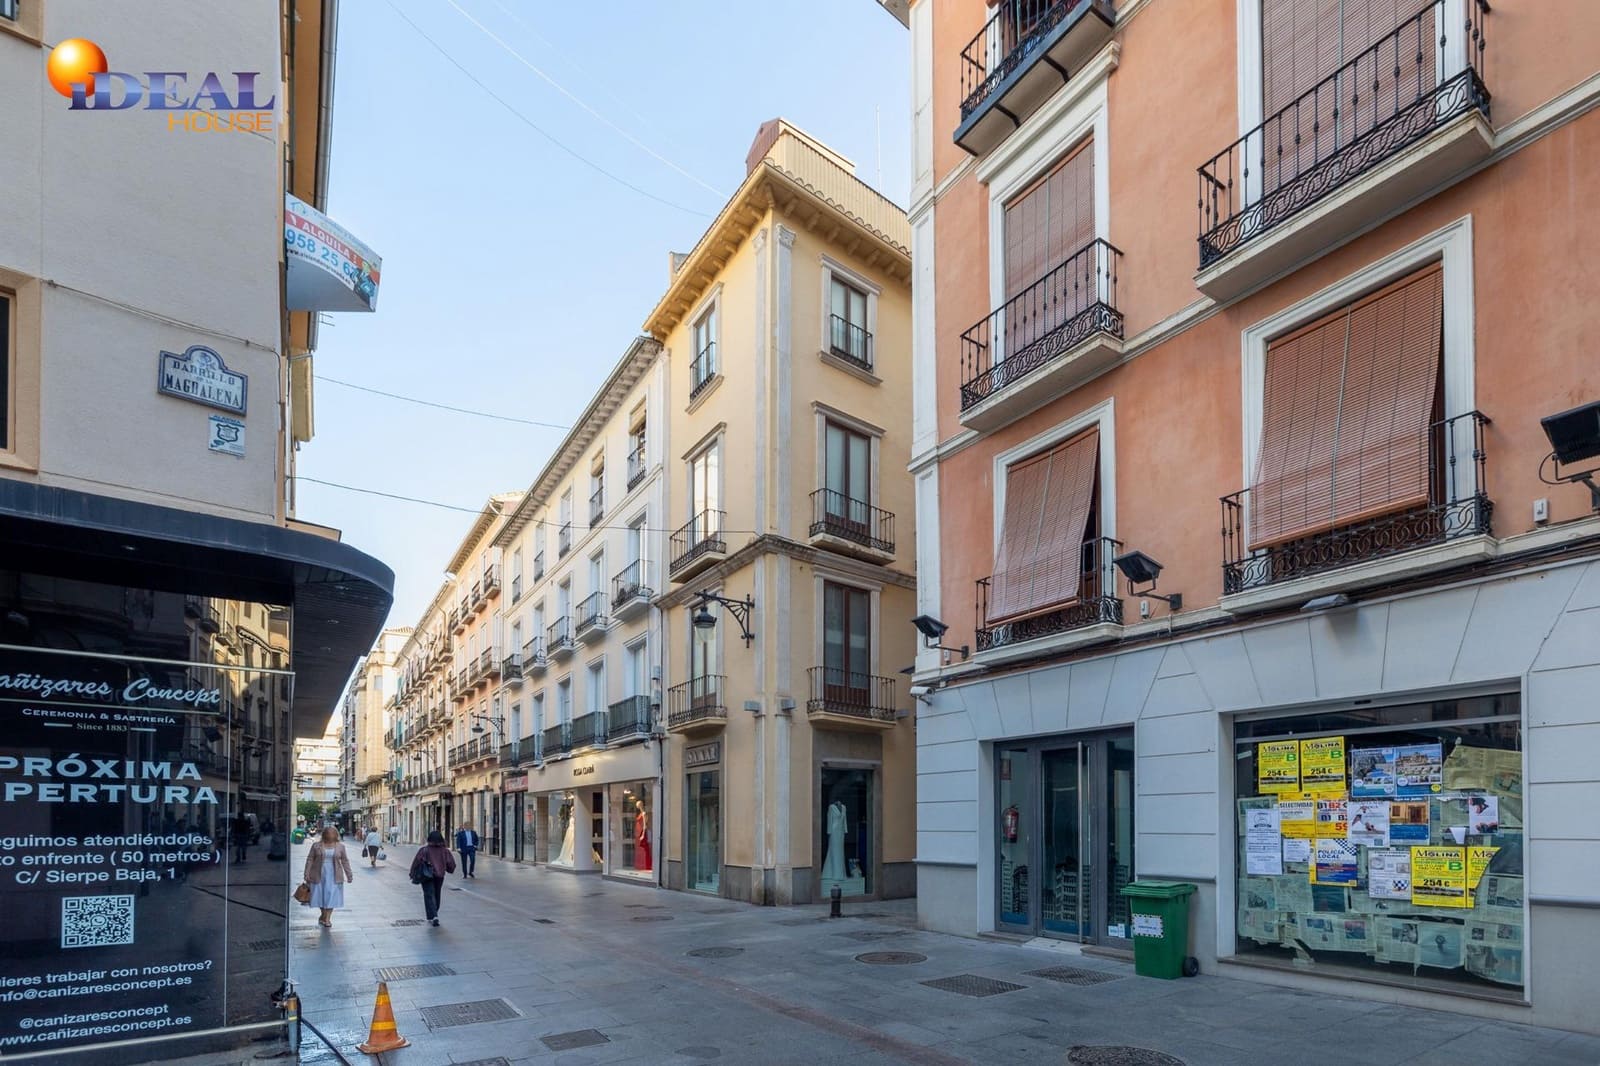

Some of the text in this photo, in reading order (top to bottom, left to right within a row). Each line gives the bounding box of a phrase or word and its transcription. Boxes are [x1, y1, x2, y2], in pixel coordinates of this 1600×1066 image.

[286, 229, 316, 253] 958
[321, 246, 339, 267] 25
[302, 222, 351, 259] ALQUILA
[165, 373, 239, 406] MAGDALENA
[122, 678, 220, 707] Concept
[22, 708, 176, 724] CEREMONIA & SASTRERÍA
[77, 722, 128, 733] Since 1883
[1286, 754, 1296, 762] B
[1330, 750, 1342, 758] B
[0, 832, 212, 850] guimos atendiéndoles
[0, 855, 15, 866] o
[22, 852, 104, 865] enfrente
[122, 851, 143, 863] 50
[150, 850, 210, 863] metros
[1448, 862, 1463, 870] B
[16, 867, 176, 885] C/ Sierpe Baja, 1
[46, 969, 107, 984] trabajar
[111, 967, 138, 978] con
[143, 960, 213, 976] nosotros?
[20, 1004, 169, 1029] @canizaresconcept
